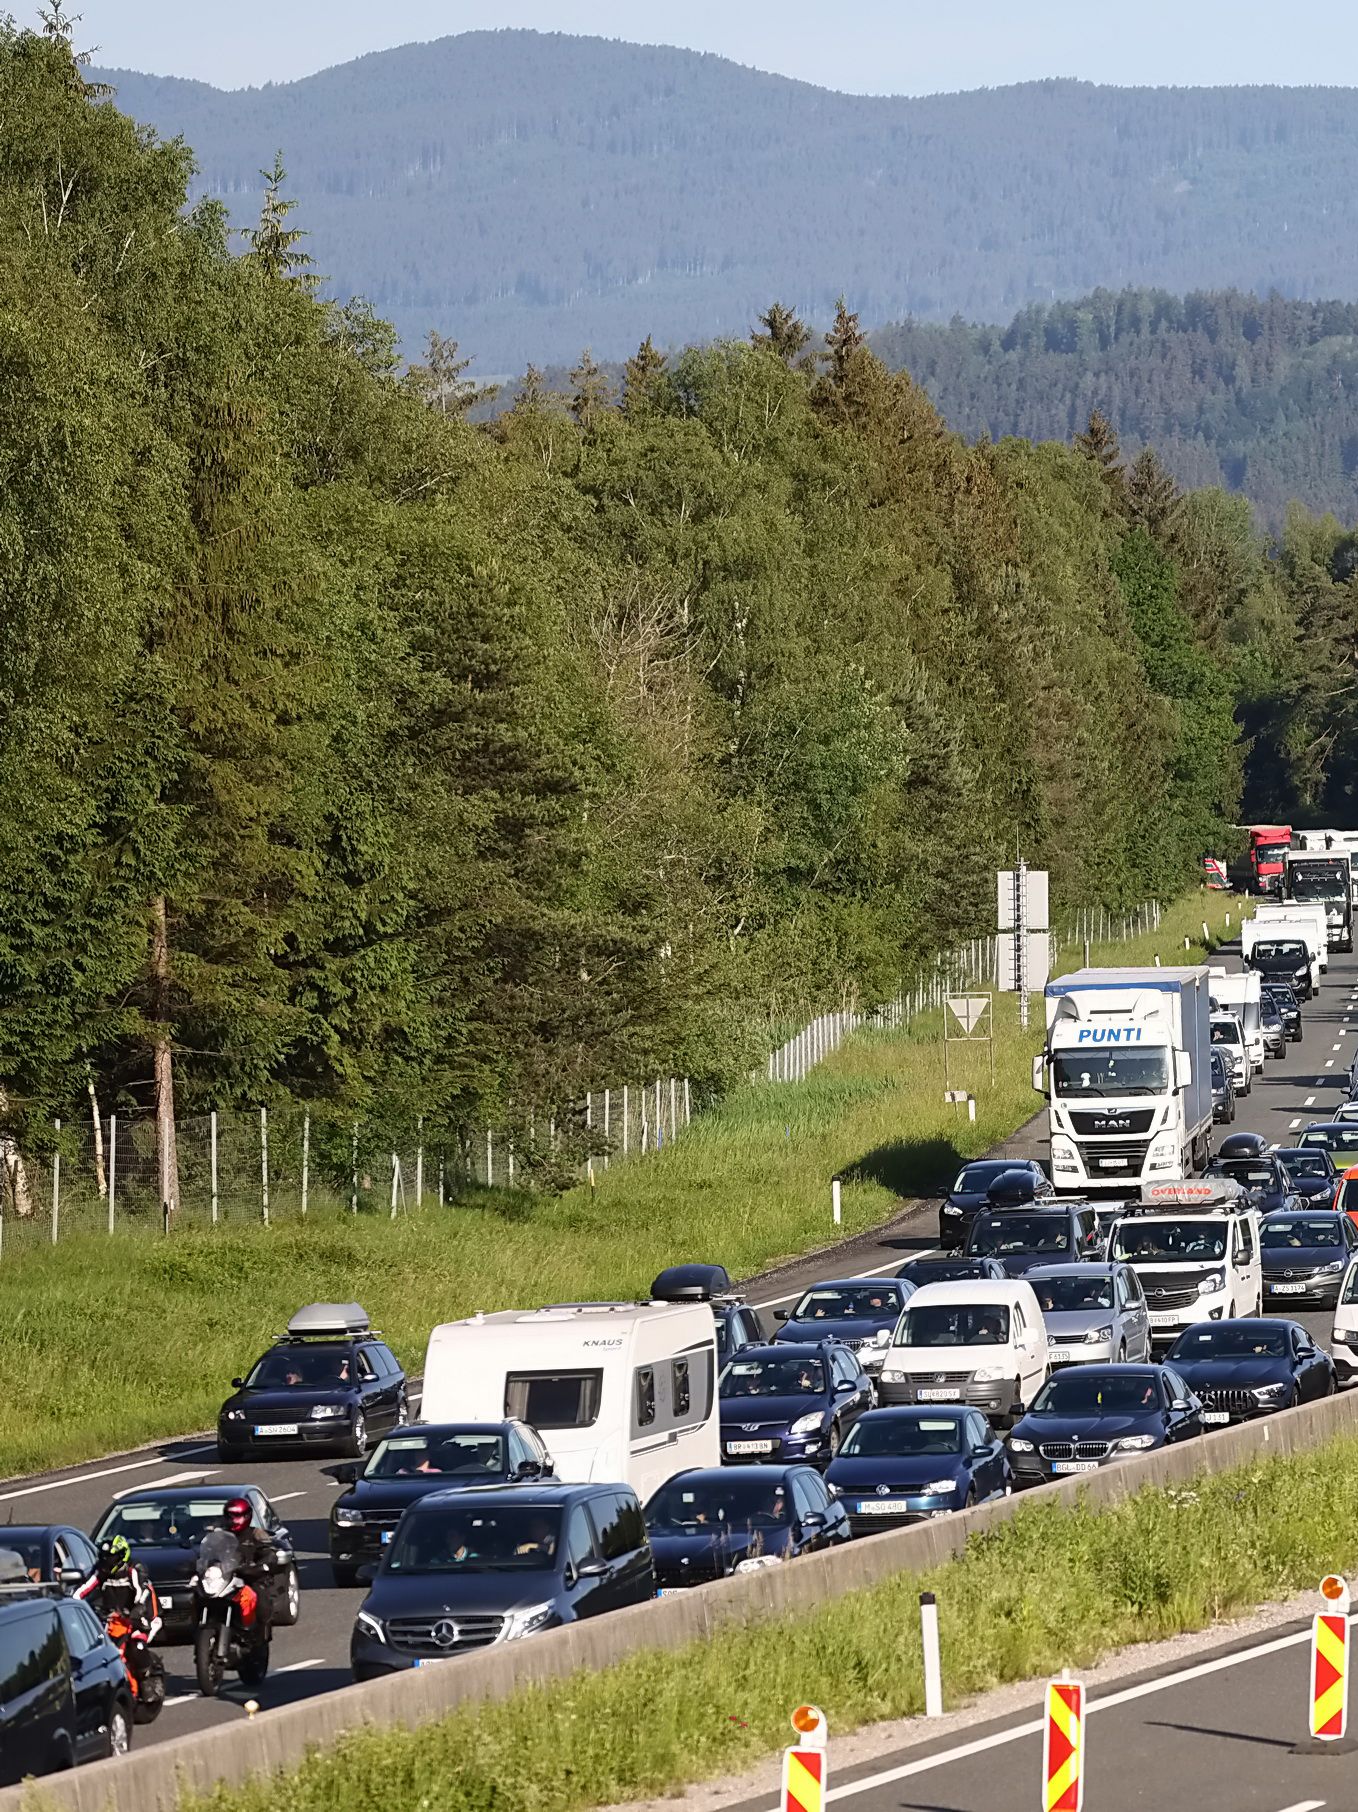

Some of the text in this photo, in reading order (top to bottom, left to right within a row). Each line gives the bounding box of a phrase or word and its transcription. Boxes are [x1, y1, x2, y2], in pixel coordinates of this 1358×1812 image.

[1078, 1028, 1142, 1043] PUNTI
[1094, 1119, 1131, 1128] MAN
[1151, 1187, 1212, 1198] OVERLAND
[582, 1338, 624, 1348] KNAUS
